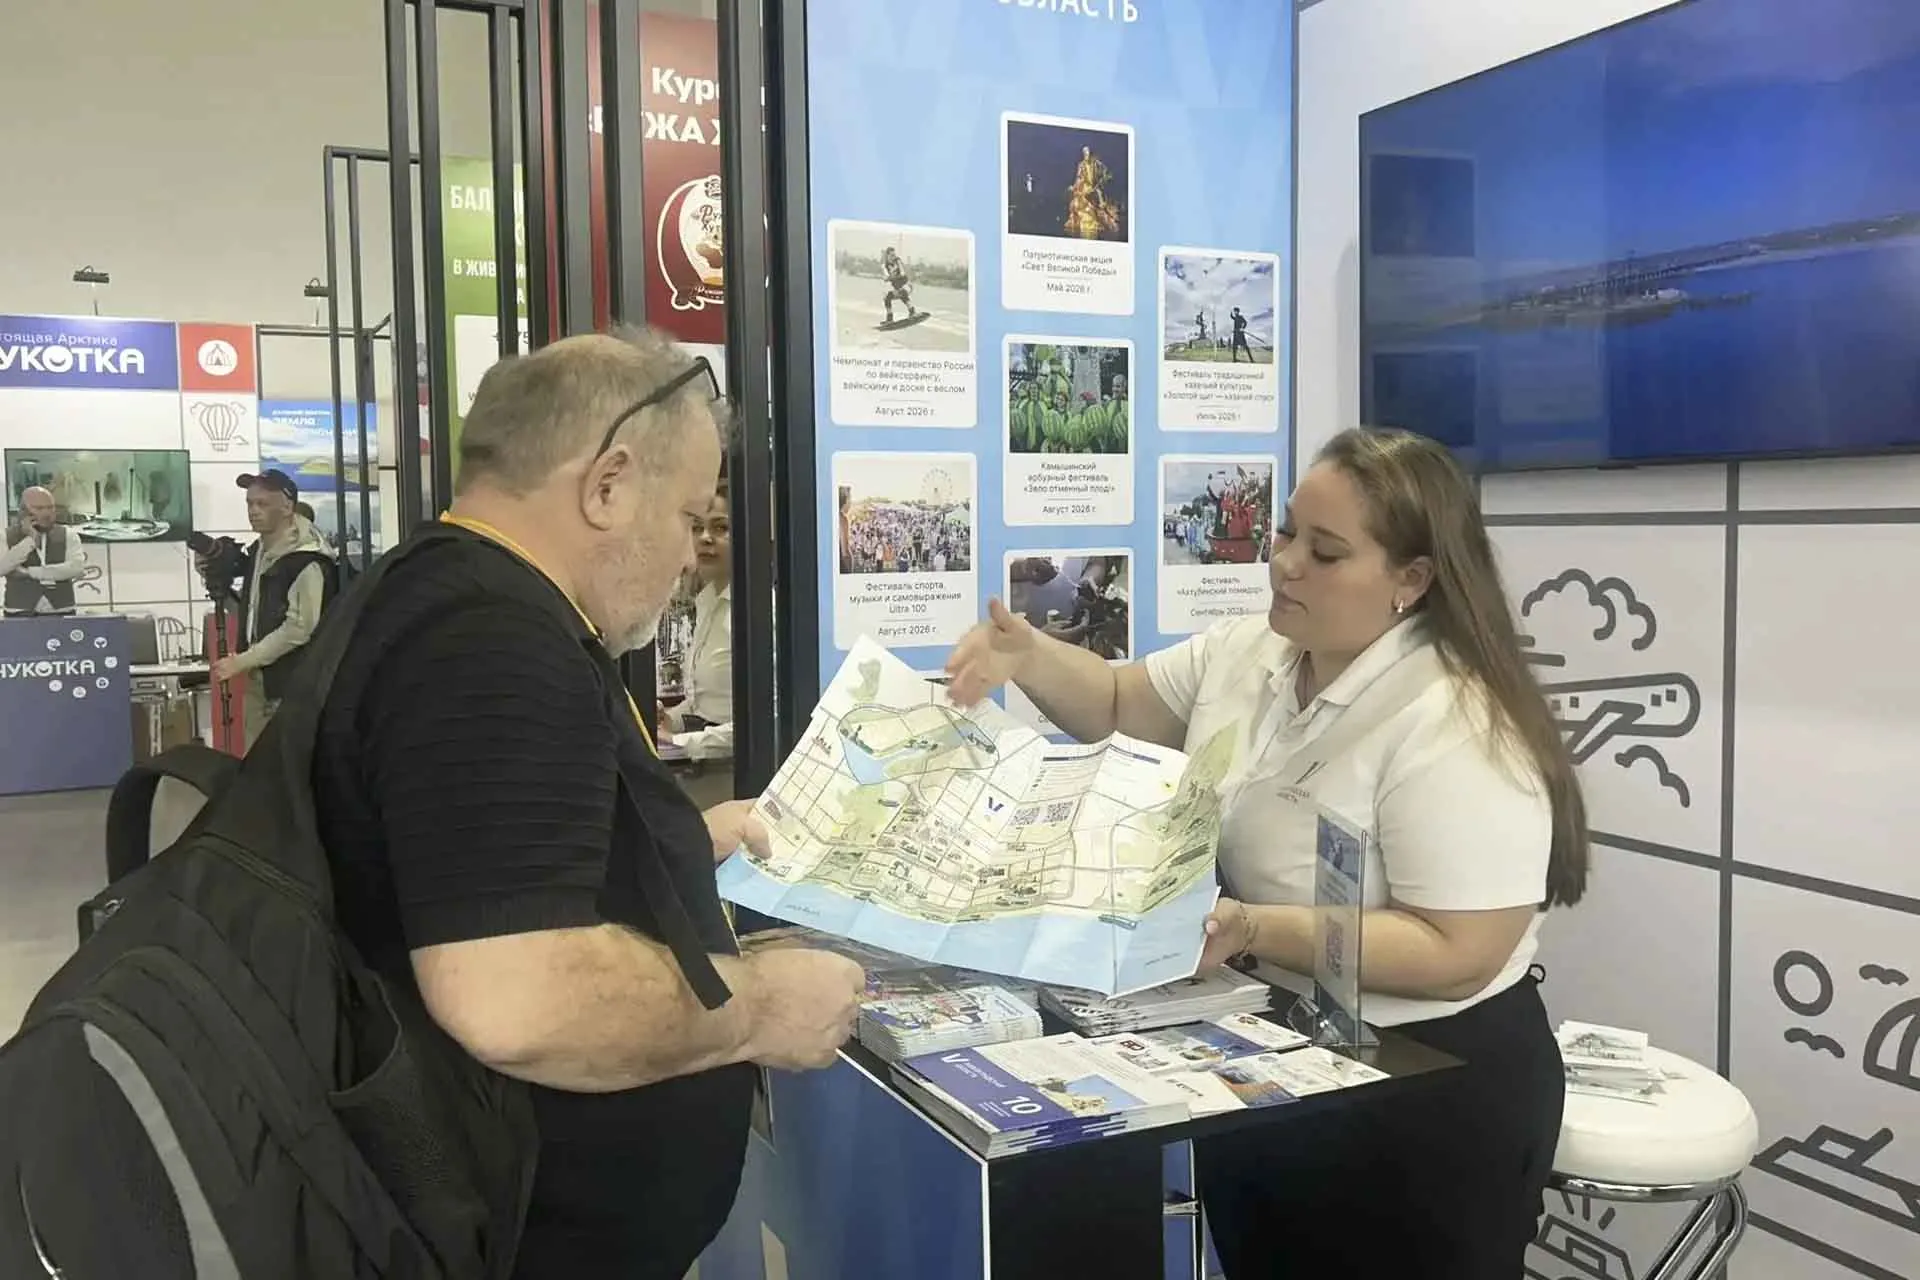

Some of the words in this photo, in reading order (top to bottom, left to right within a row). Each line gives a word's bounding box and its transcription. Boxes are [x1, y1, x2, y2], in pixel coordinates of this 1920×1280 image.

[998, 0, 1138, 22] АСТЬ
[652, 67, 719, 105] Кур
[453, 259, 462, 275] В
[57, 332, 118, 347] Арктика
[833, 356, 881, 367] Чемпионат
[892, 360, 941, 370] первенство
[943, 361, 974, 370] России
[866, 370, 877, 378] по
[899, 385, 925, 393] доске
[875, 406, 904, 416] Август
[907, 407, 928, 416] 2026
[1041, 462, 1096, 471] Камышинский
[1028, 473, 1066, 483] арбузный
[1068, 474, 1109, 483] фестиваль
[1042, 505, 1069, 515] Август
[1071, 504, 1090, 513] 2026
[865, 582, 912, 591] Фестиваль
[849, 595, 883, 606] музыки
[892, 592, 962, 603] самовыражения
[911, 604, 927, 613] 100
[878, 627, 907, 637] Август
[909, 625, 930, 634] 2026
[0, 660, 95, 678] ЧУКОТКА
[1001, 1096, 1042, 1114] 10
